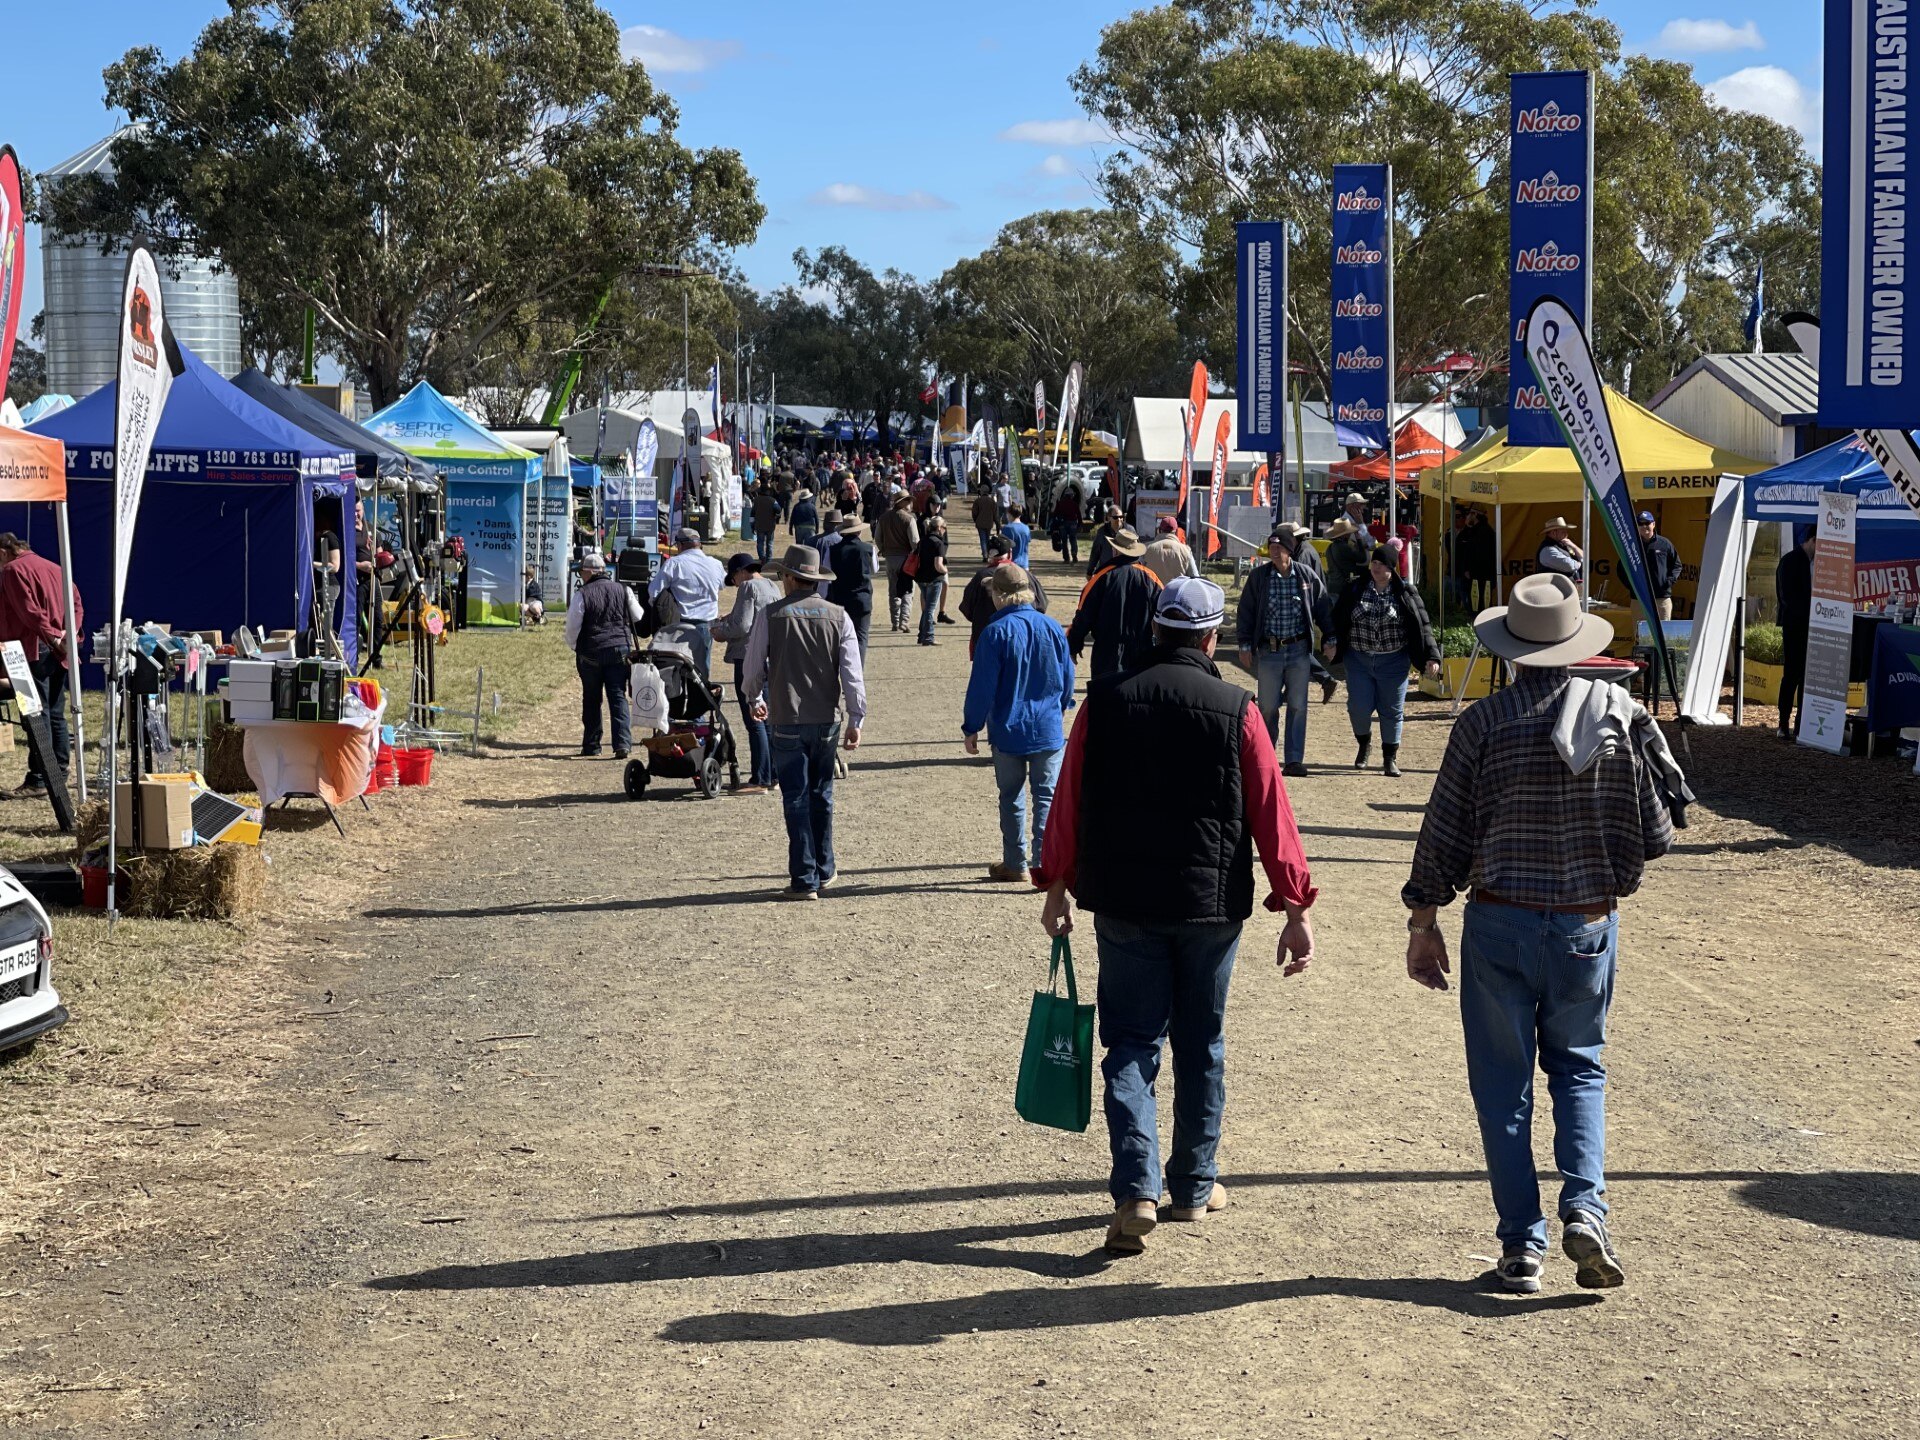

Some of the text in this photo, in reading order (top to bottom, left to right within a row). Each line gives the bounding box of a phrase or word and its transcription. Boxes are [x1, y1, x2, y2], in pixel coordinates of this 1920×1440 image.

[1517, 108, 1581, 133] Norco
[1516, 179, 1581, 203] Norco
[1870, 0, 1906, 387] AUSTRALIAN FARMER OWNED
[1337, 192, 1382, 211] Norco
[1336, 245, 1382, 264] Norco
[1516, 248, 1580, 272] Norco
[1336, 299, 1383, 317] Norco
[1257, 240, 1272, 434] 100% AUSTRALIAN FARMER OWNED
[1336, 351, 1384, 369] Norco
[1338, 403, 1385, 421] Norco
[395, 421, 453, 431] SEPTIC
[395, 430, 450, 439] SCIENCE
[207, 450, 294, 465] 1300 763 031
[207, 470, 294, 481] Hire Sales Service
[468, 464, 513, 476] Control
[484, 519, 511, 528] Dams
[1826, 511, 1846, 531] Ozgyp
[478, 530, 517, 540] Troughs
[482, 542, 512, 550] Ponds
[17, 948, 36, 969] R35
